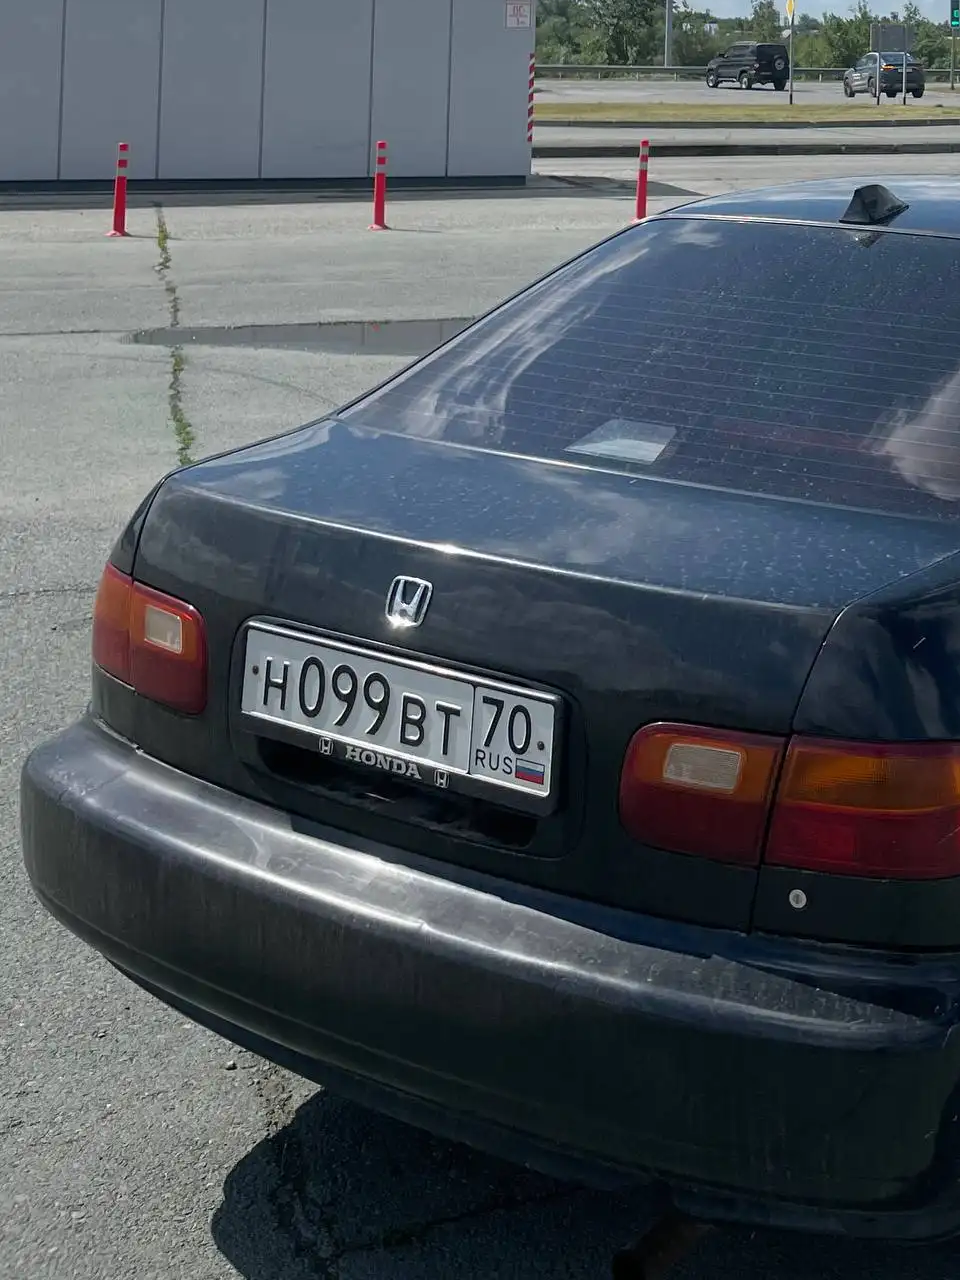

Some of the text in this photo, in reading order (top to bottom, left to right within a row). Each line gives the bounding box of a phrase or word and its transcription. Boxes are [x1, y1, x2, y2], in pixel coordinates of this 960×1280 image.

[482, 695, 532, 755] 70
[345, 745, 422, 780] HONDA
[475, 748, 513, 776] RUS
